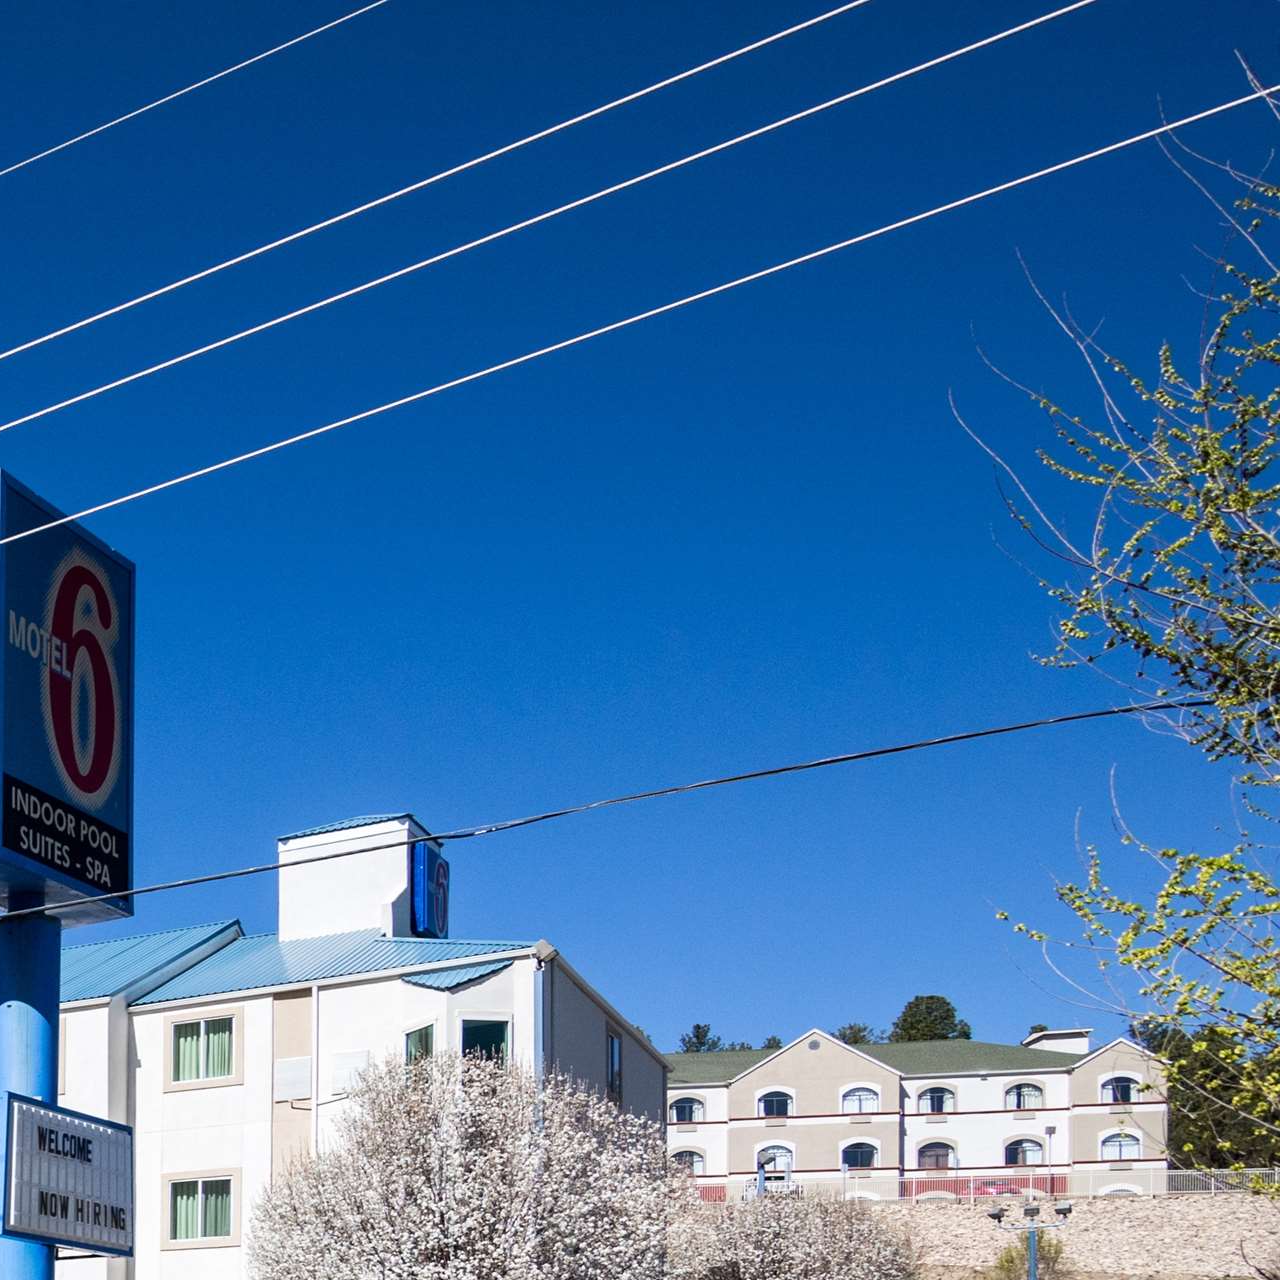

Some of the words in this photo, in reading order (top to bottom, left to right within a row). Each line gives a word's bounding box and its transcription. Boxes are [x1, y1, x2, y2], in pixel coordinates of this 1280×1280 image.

[9, 609, 72, 678] MOTEL
[46, 561, 117, 798] 6
[12, 786, 76, 838] INDOOR
[80, 820, 119, 858] POOL
[20, 825, 70, 868] SUITES
[86, 856, 112, 888] SPA
[38, 1126, 93, 1163] WELCOME
[40, 1191, 70, 1220] NOW
